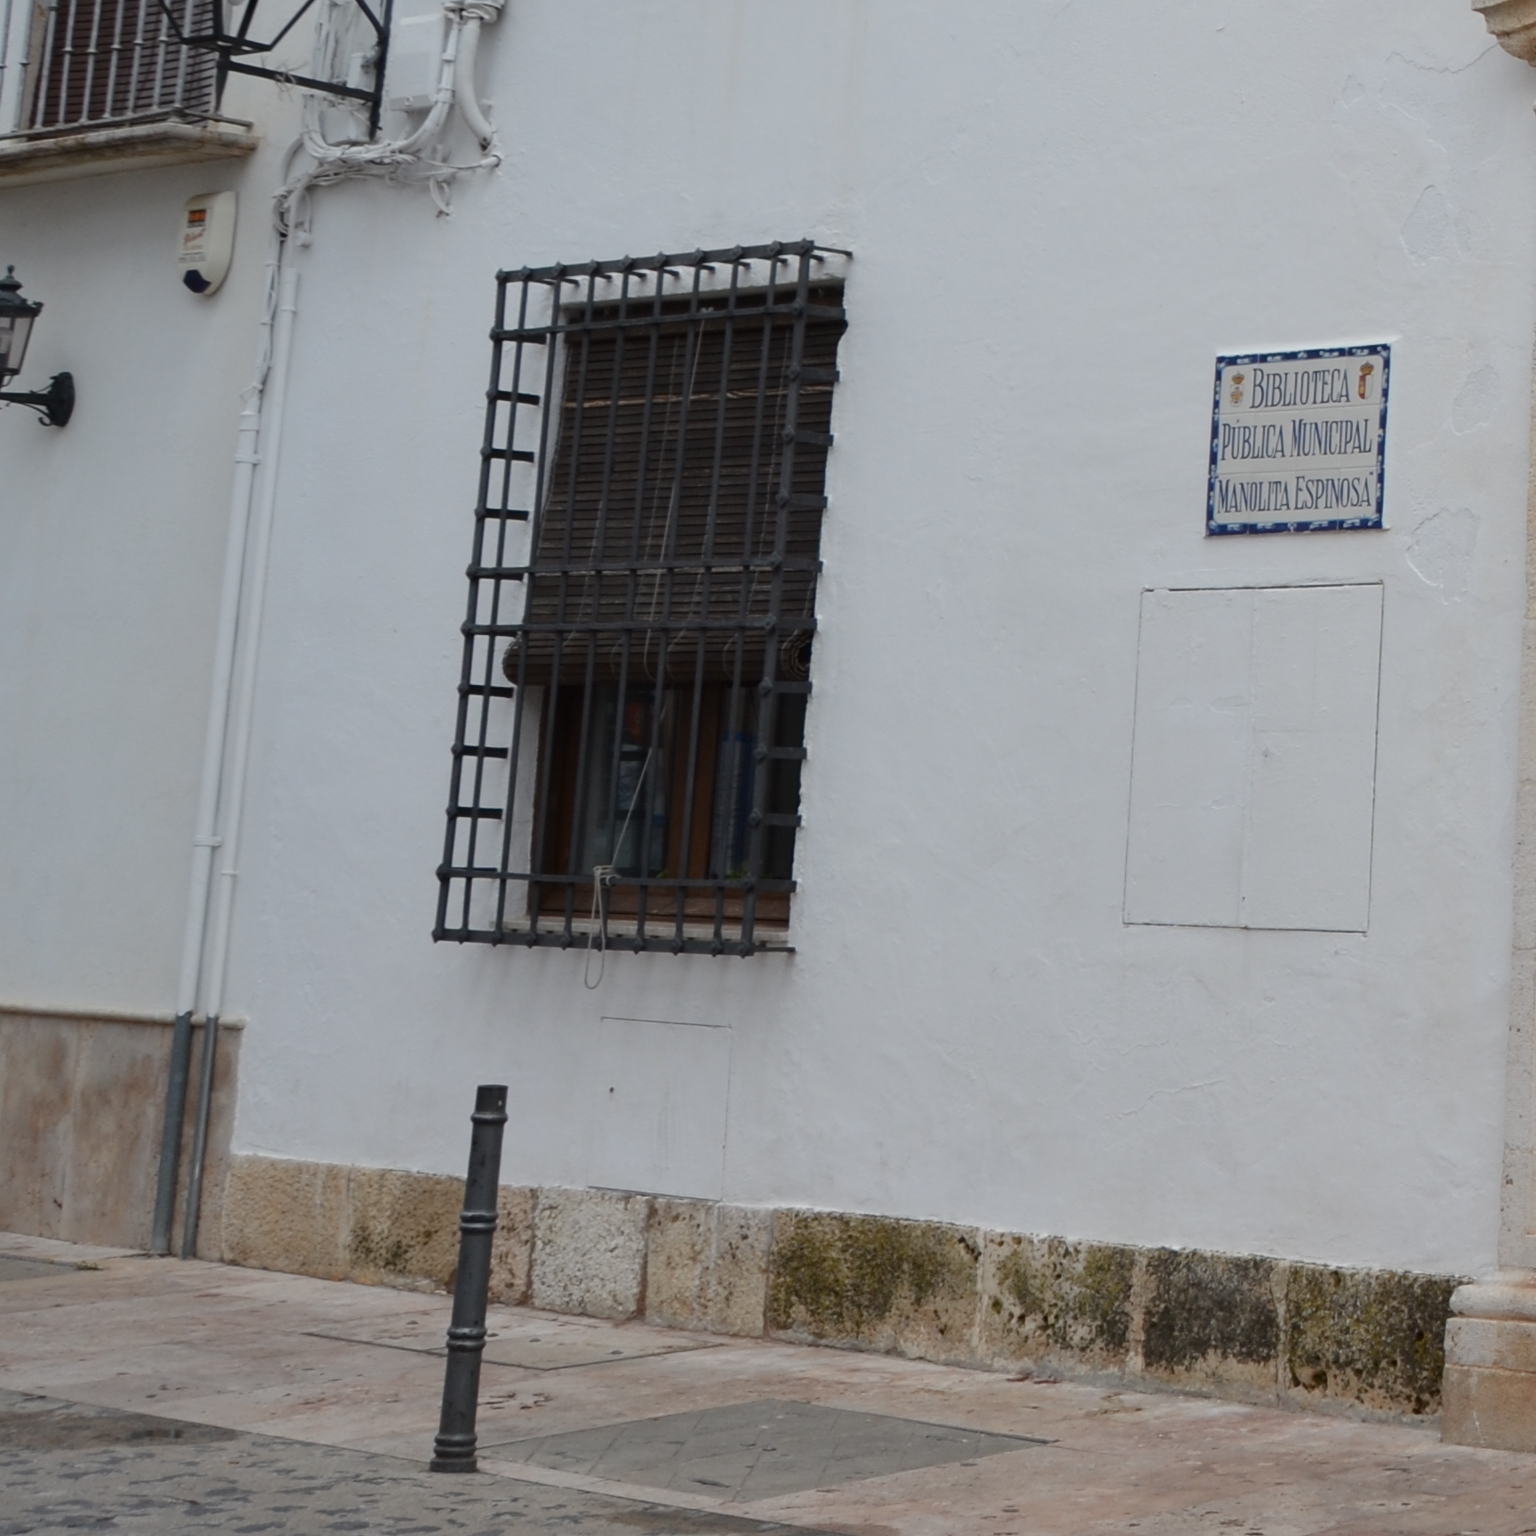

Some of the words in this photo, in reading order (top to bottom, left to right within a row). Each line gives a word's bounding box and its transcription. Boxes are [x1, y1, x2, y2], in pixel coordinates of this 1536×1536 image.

[1249, 368, 1351, 409] BIBLIOTECA
[1220, 419, 1286, 461] PÚBLICA
[1290, 418, 1373, 458] MUNICIPAL
[1217, 479, 1290, 514] MANOLITA
[1293, 476, 1372, 511] ESPINOSA
